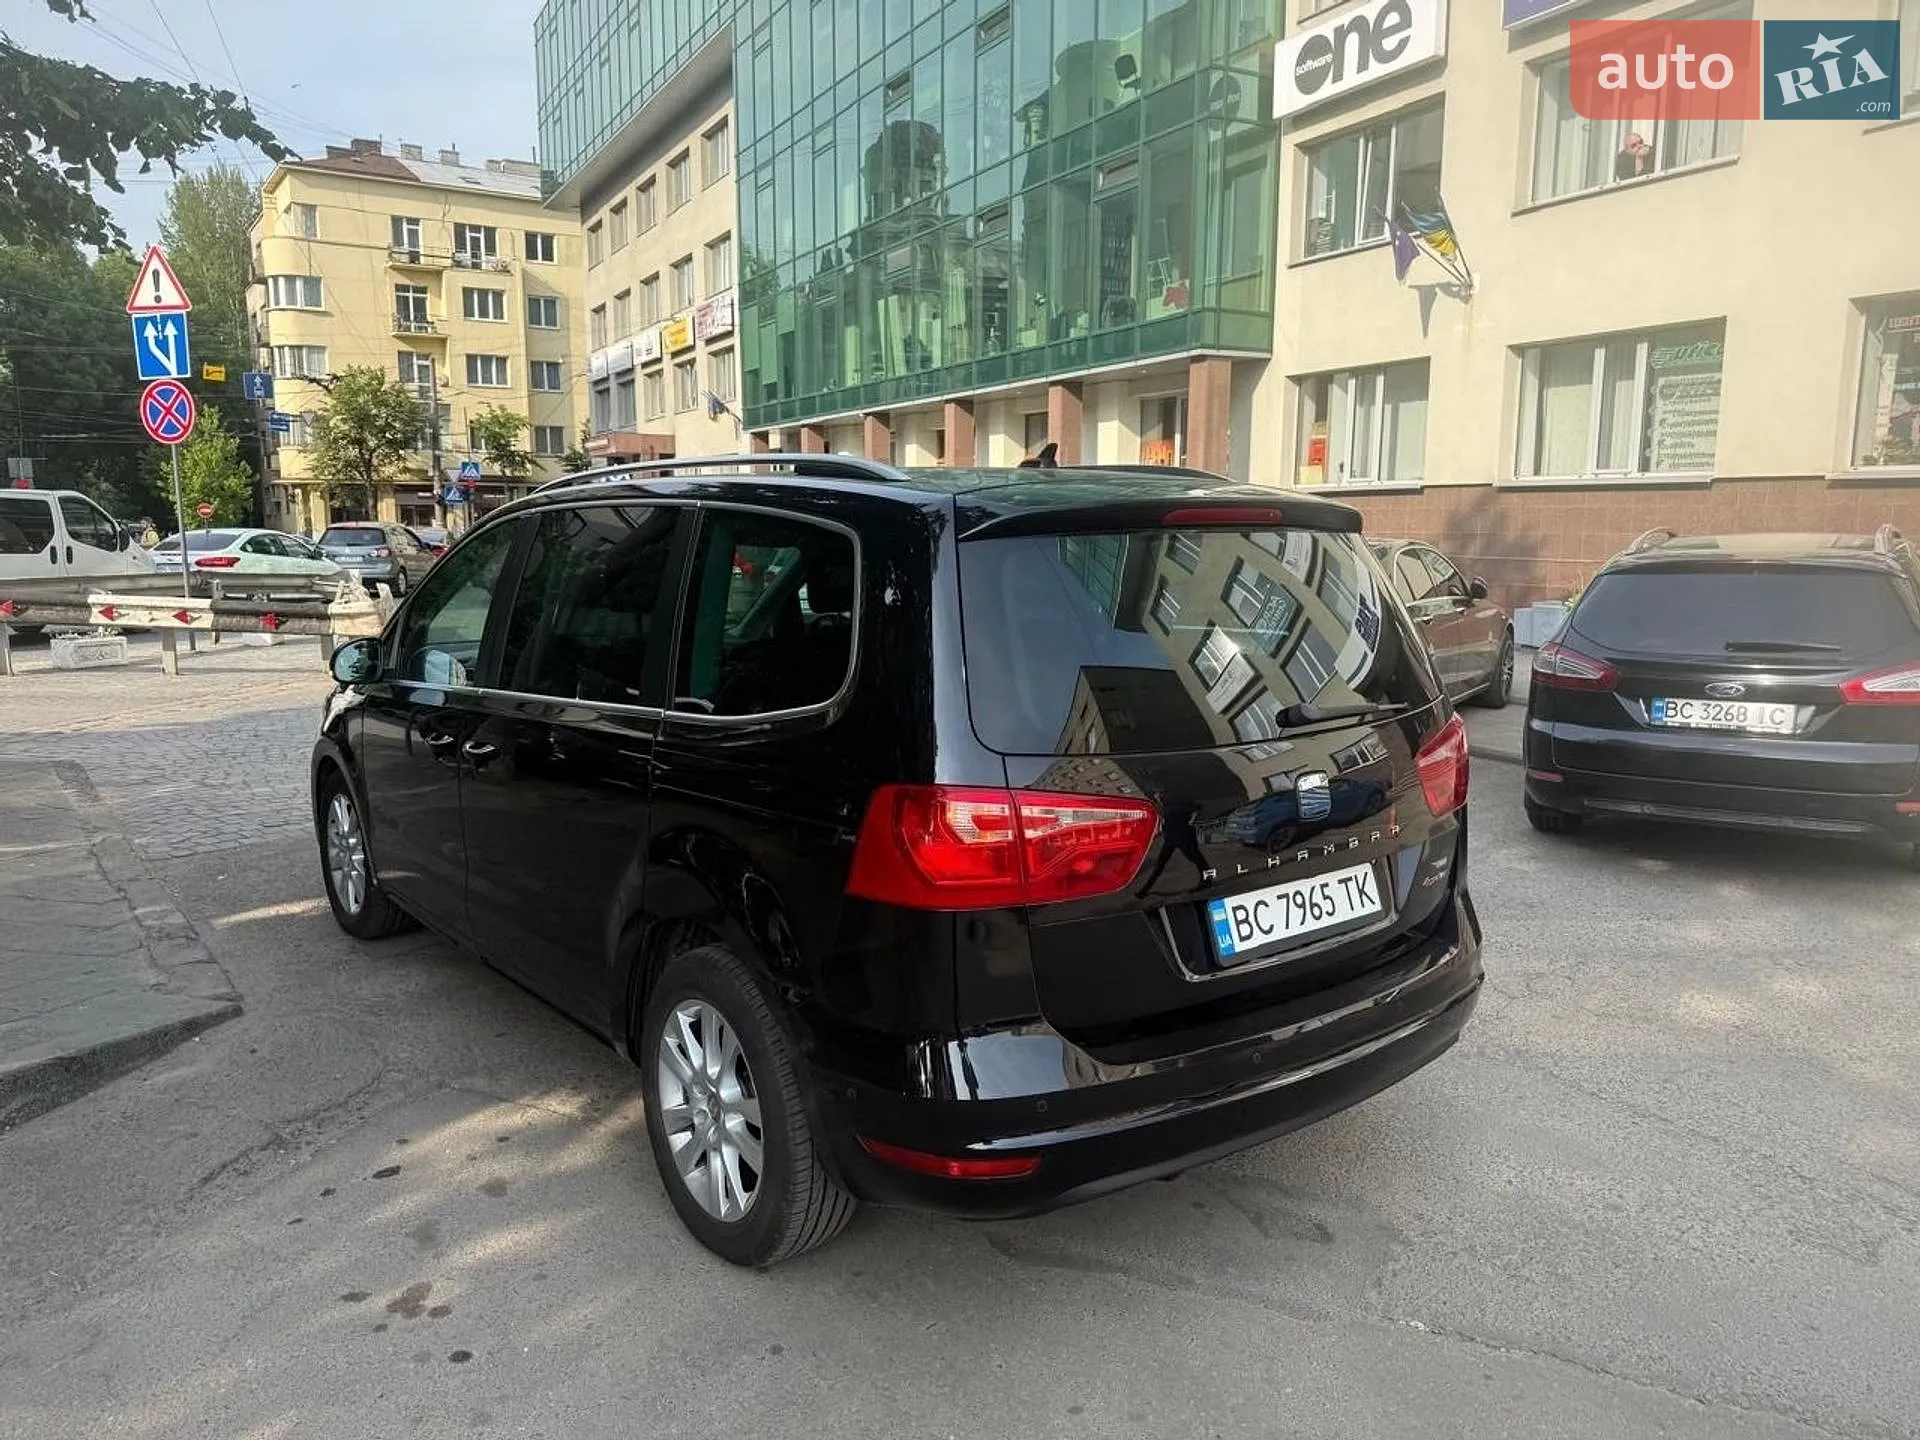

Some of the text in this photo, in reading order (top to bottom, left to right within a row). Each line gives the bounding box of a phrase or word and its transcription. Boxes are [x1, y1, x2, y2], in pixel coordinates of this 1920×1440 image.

[1295, 53, 1333, 76] software
[1664, 700, 1694, 720] BC
[1699, 702, 1748, 722] 3268
[1202, 824, 1404, 881] ALHAMBRA
[1231, 870, 1376, 943] BC 7965 TK
